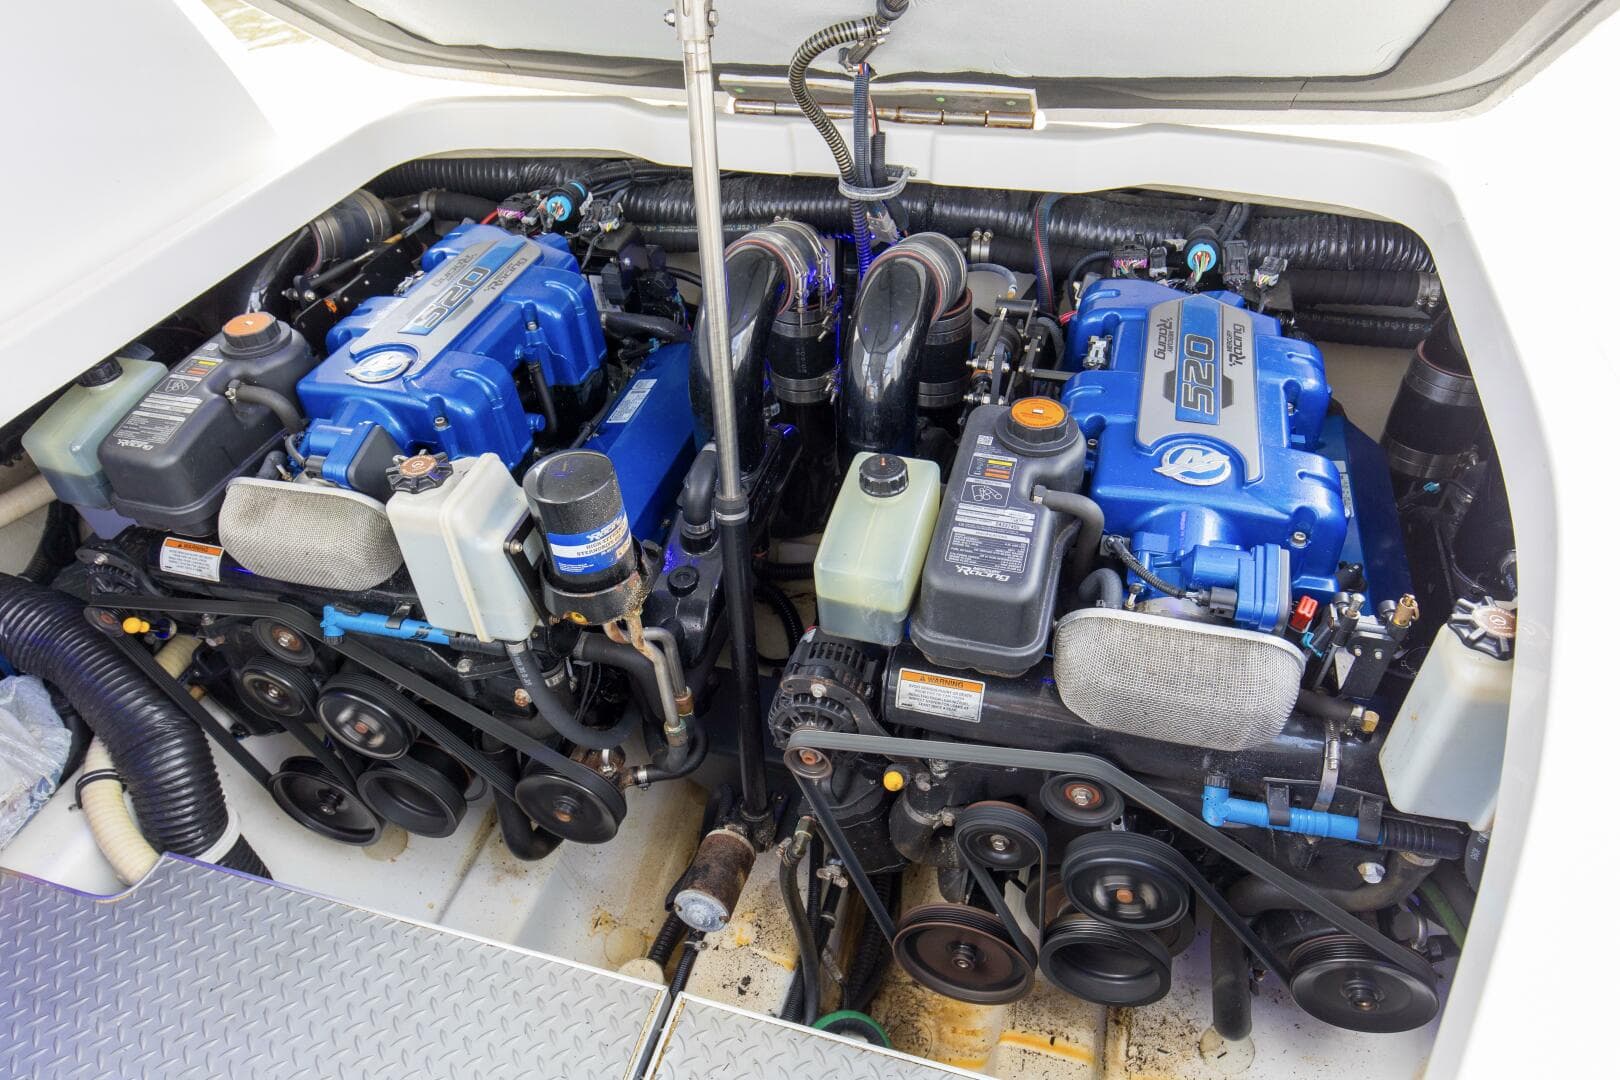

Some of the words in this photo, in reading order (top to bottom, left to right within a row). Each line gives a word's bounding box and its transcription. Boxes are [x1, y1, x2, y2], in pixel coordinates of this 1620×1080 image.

[415, 265, 491, 329] 520
[1154, 317, 1173, 360] Racing
[1228, 323, 1246, 367] Racing
[1181, 333, 1216, 416] 520
[927, 676, 964, 688] WARNING
